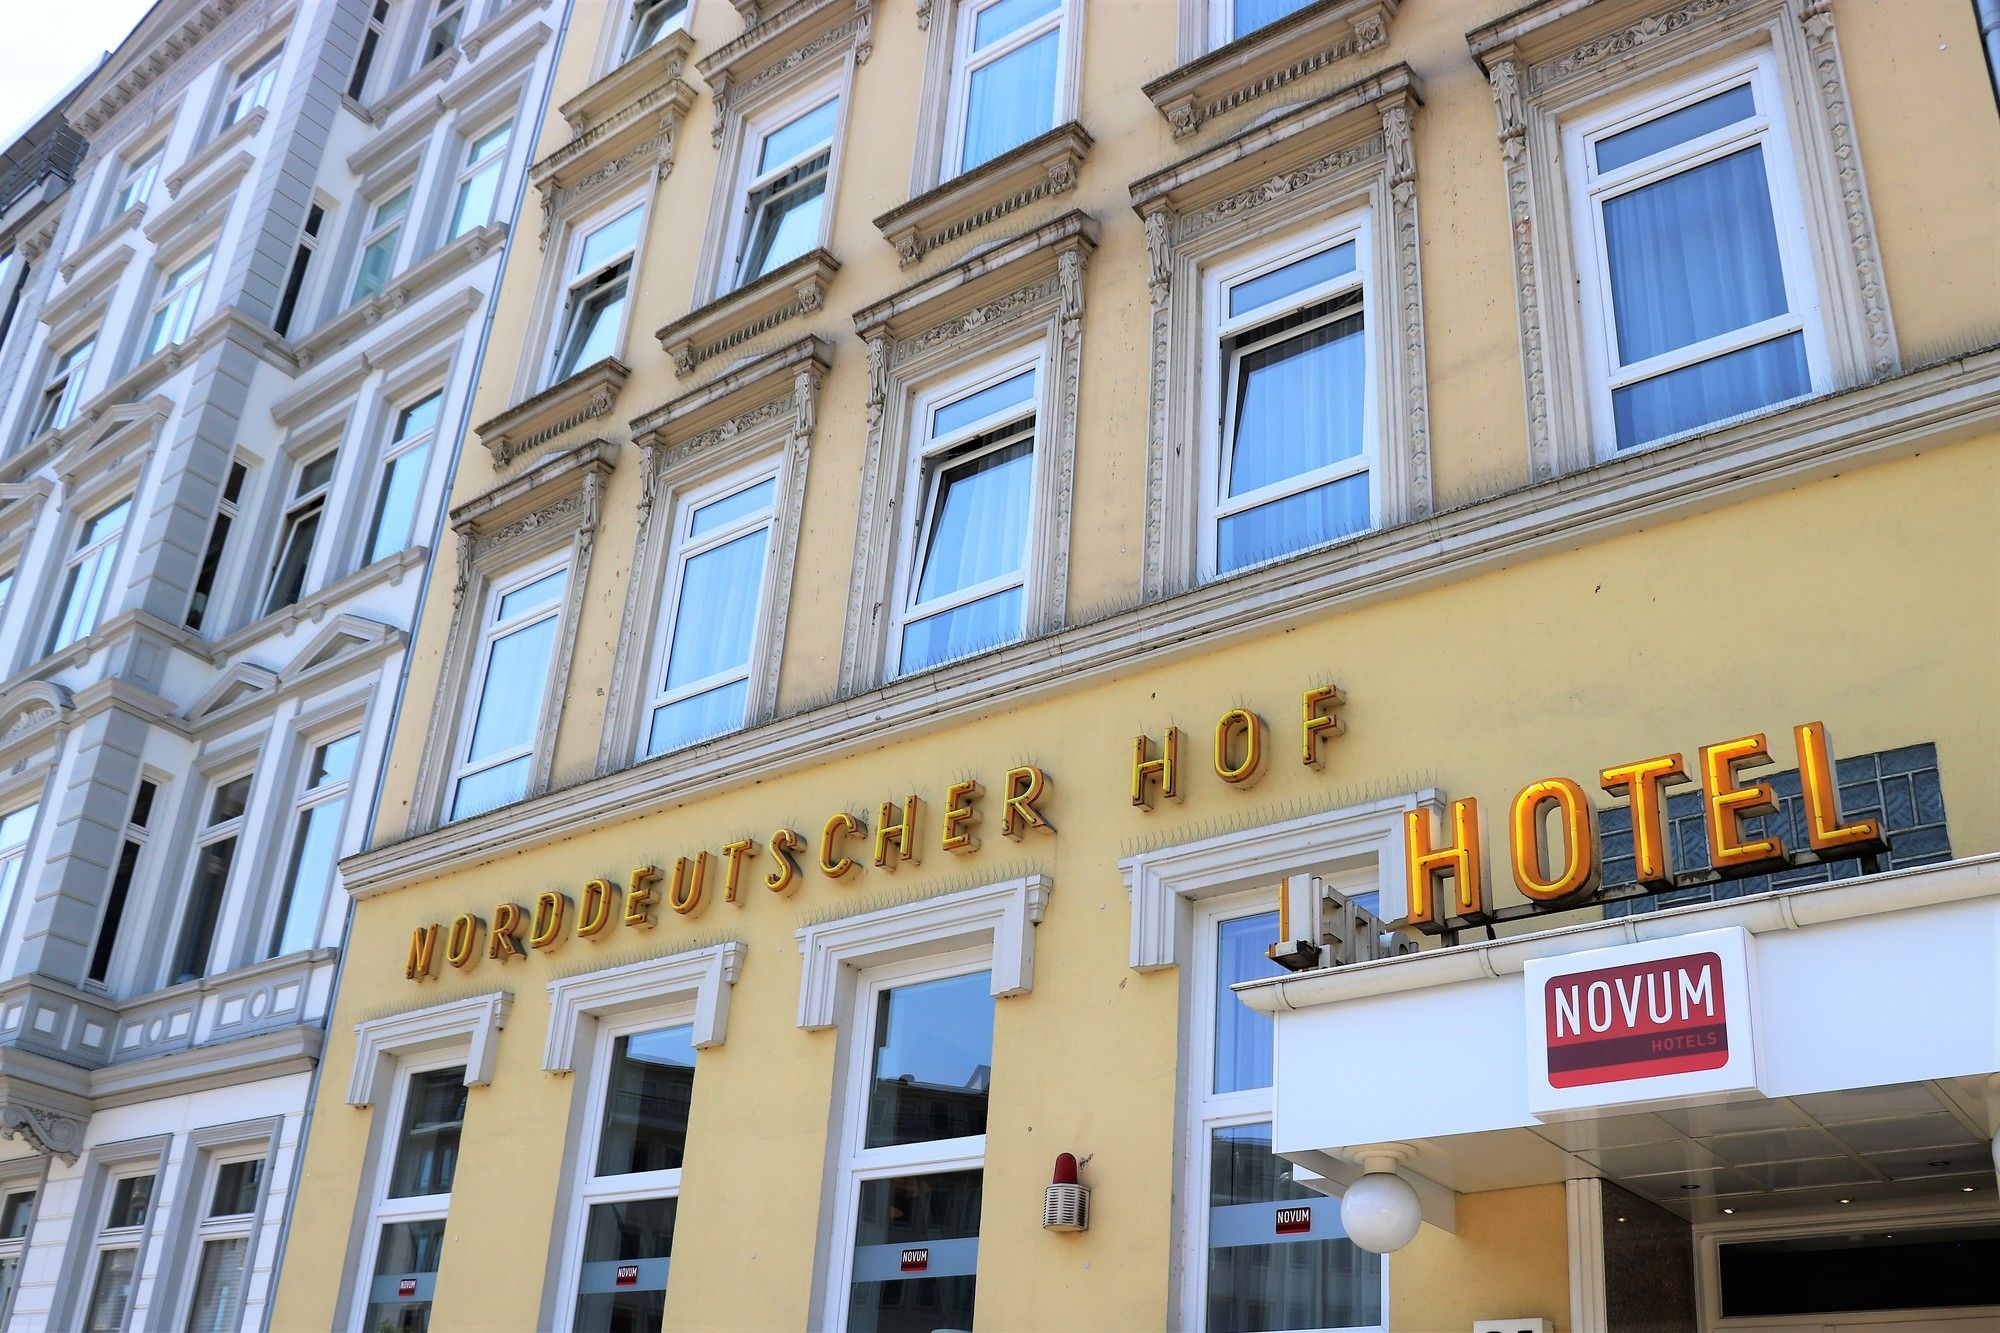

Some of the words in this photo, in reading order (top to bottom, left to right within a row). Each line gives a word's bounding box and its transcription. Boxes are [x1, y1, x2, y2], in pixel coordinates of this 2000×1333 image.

[406, 765, 1057, 981] NORDDEUTSCHER
[1131, 684, 1346, 812] HOF
[1404, 721, 1889, 934] HOTEL
[1555, 964, 1714, 1038] NOVUM
[1651, 1031, 1717, 1053] HOTELS
[1277, 1209, 1309, 1224] NOVUM
[902, 1250, 928, 1263] NOVUM
[617, 1267, 638, 1278] NOVUM
